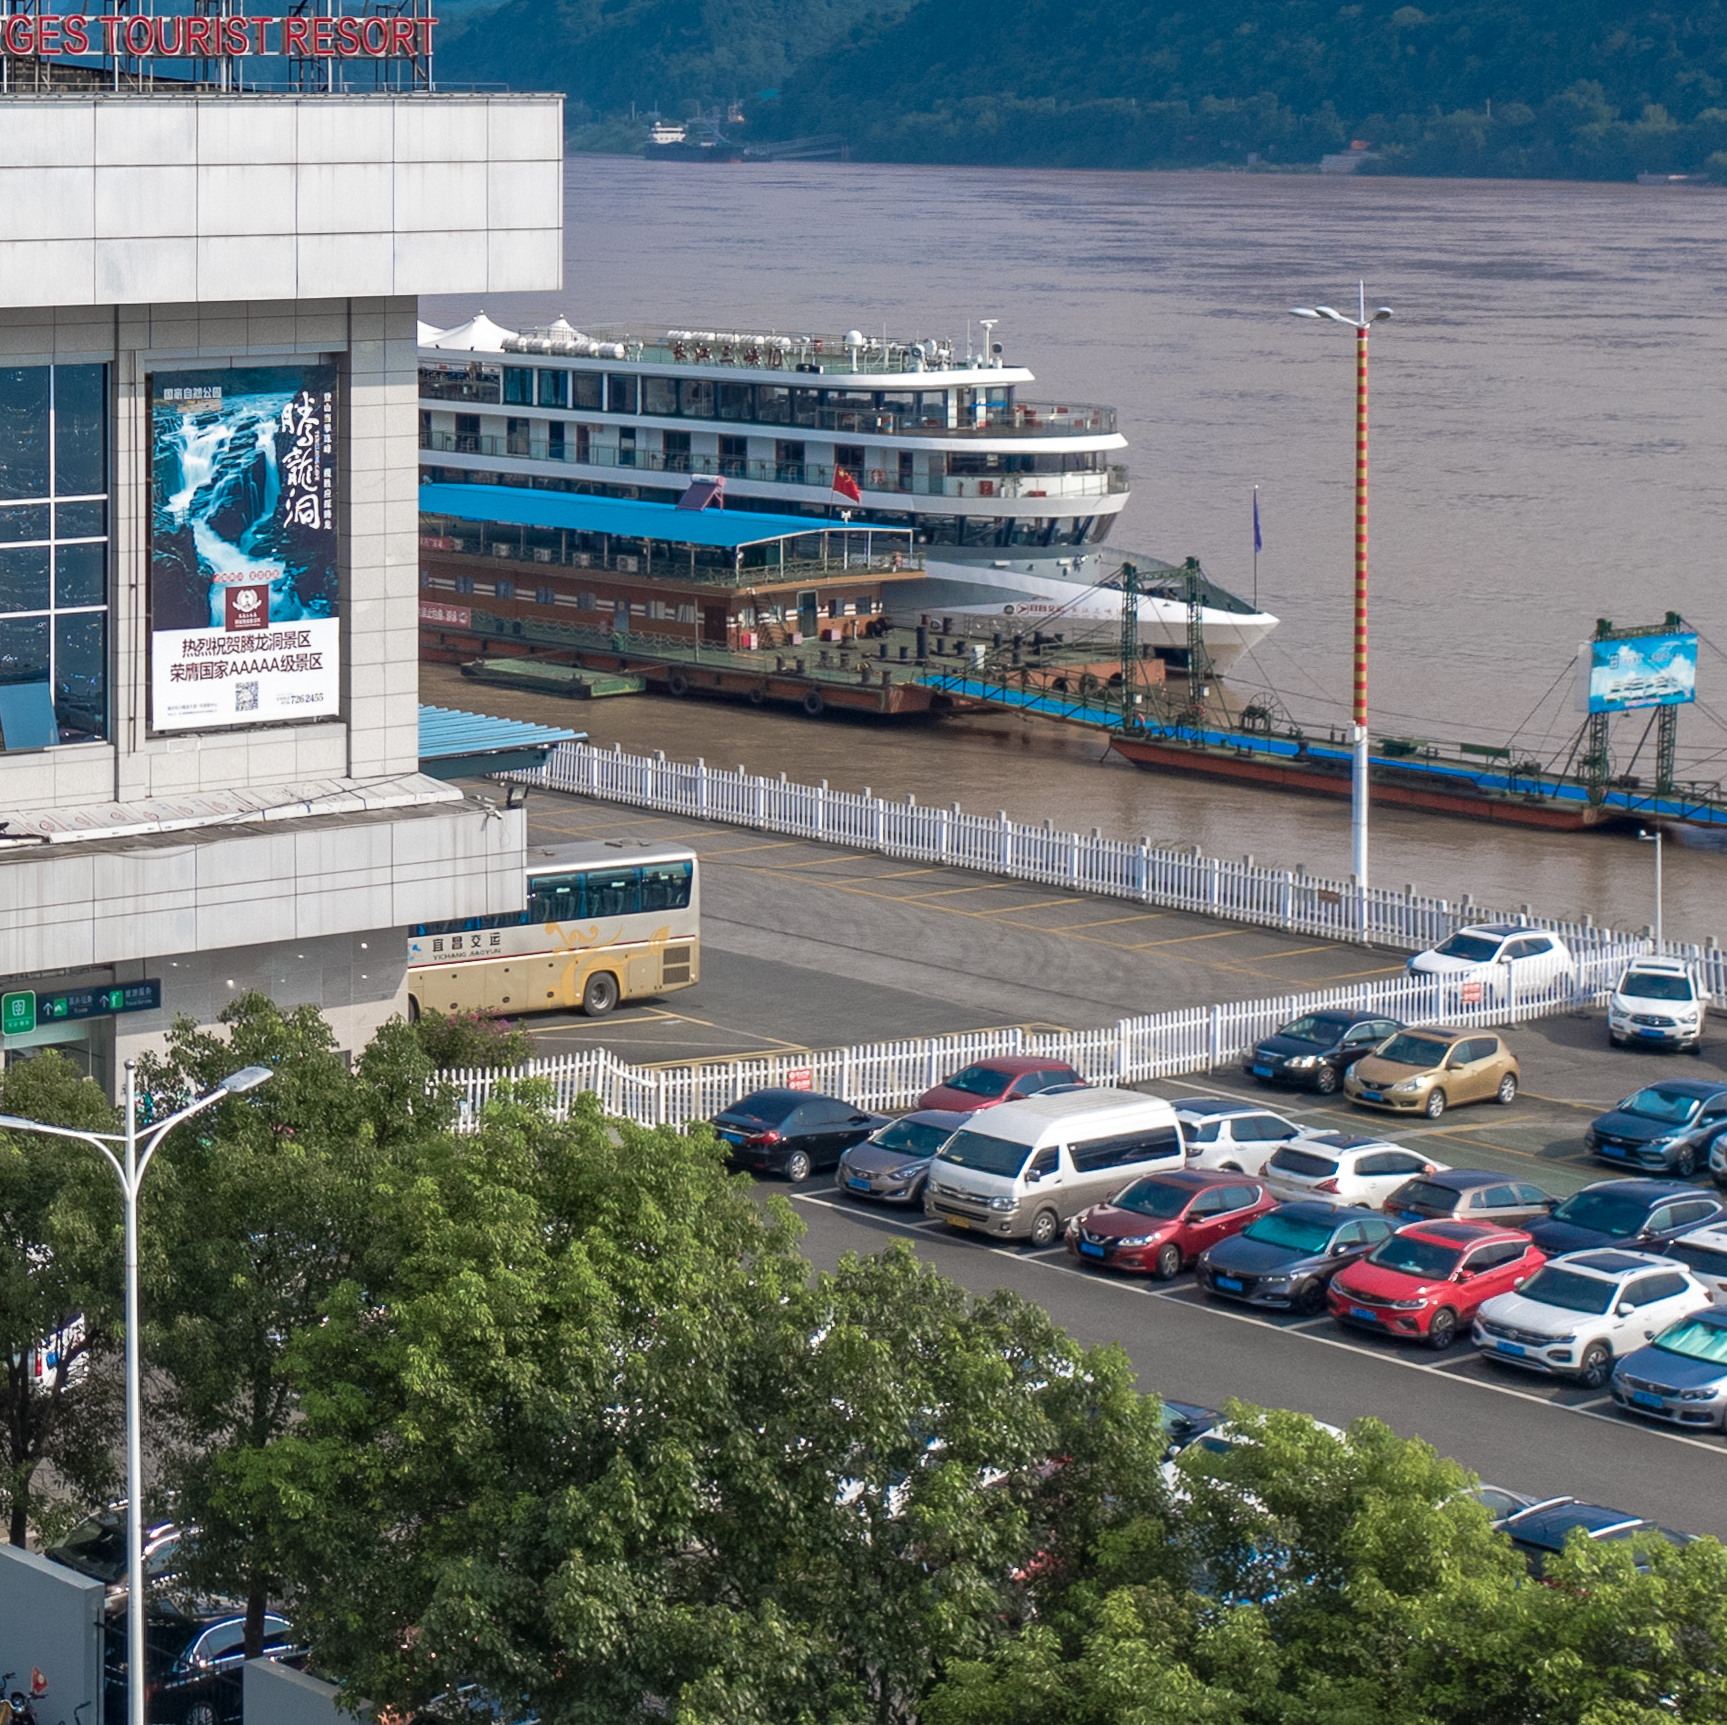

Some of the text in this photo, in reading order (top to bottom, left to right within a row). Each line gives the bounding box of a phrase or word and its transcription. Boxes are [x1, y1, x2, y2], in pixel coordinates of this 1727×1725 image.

[100, 15, 274, 57] TOURIST
[284, 16, 439, 57] RESORT
[182, 630, 312, 658] 热烈祝贺腾龙洞景区
[170, 653, 323, 682] 荣膺国家AAAAA级景区
[433, 932, 500, 952] 宜昌交运
